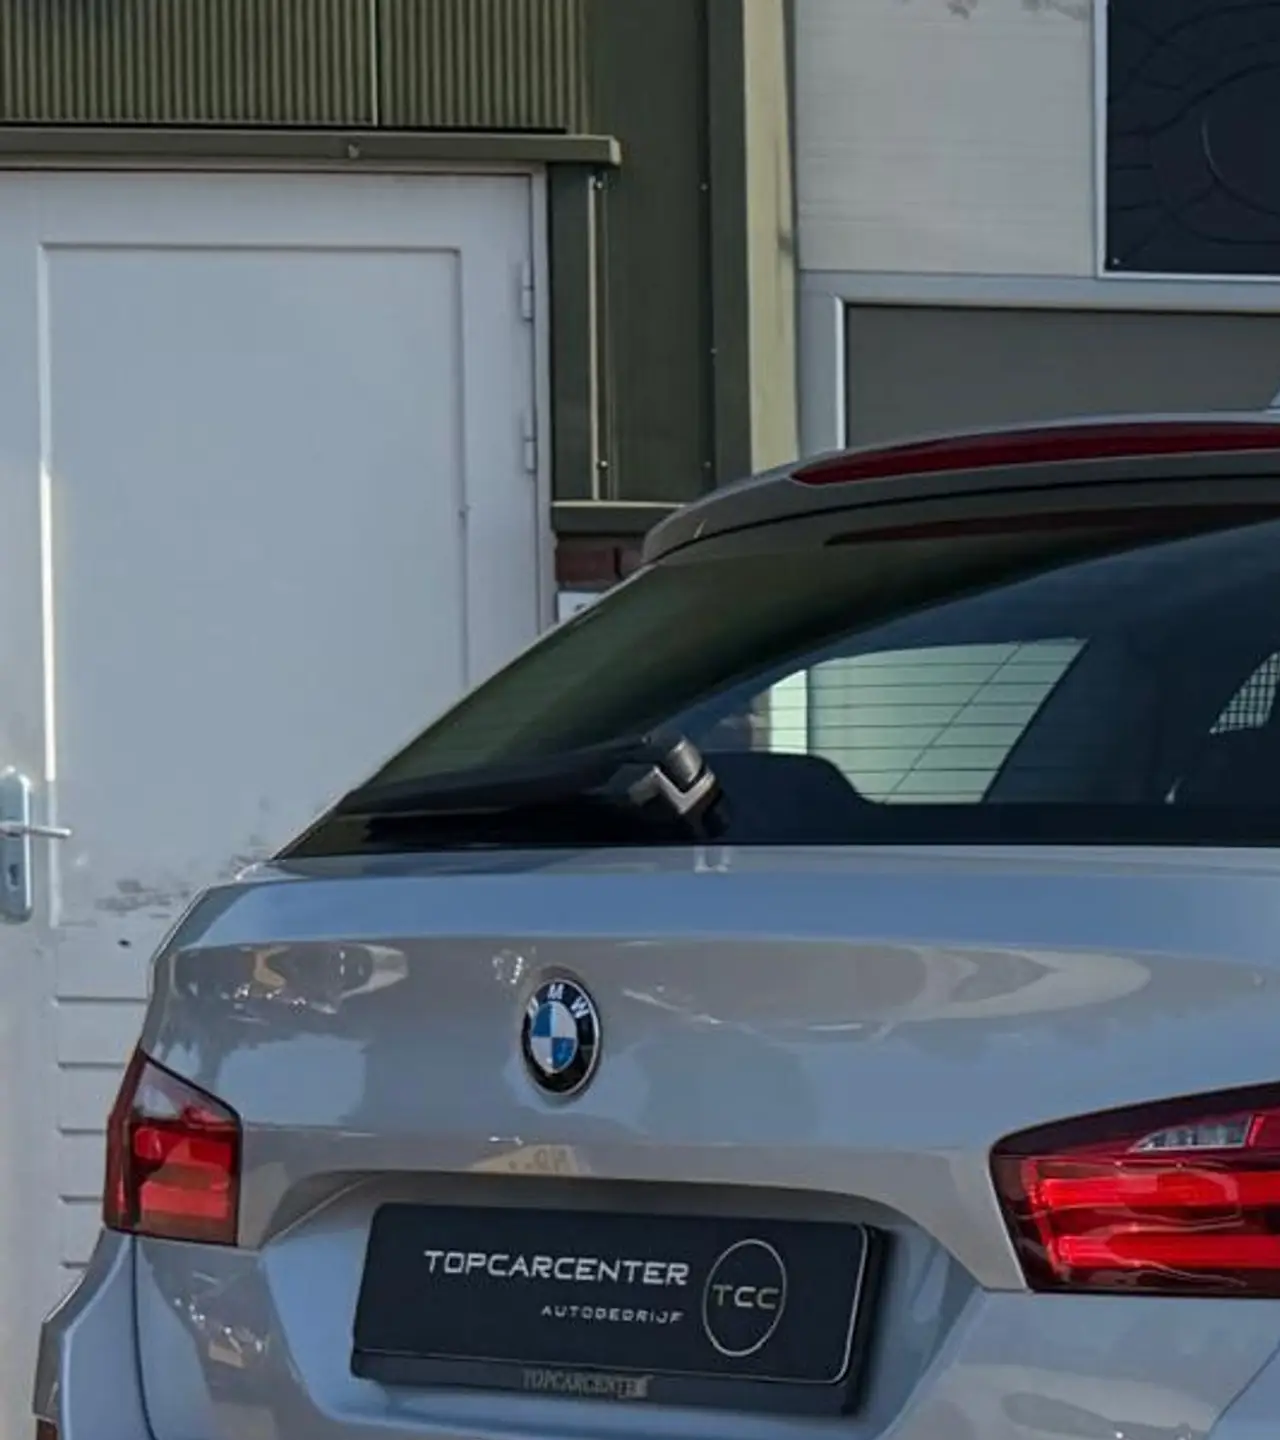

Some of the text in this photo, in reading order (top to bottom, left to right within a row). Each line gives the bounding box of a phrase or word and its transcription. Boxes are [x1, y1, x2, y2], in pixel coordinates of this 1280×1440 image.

[424, 1249, 690, 1287] TOPCARCENTER
[712, 1283, 781, 1310] TCC
[540, 1304, 685, 1325] AUTOBEDRIJF
